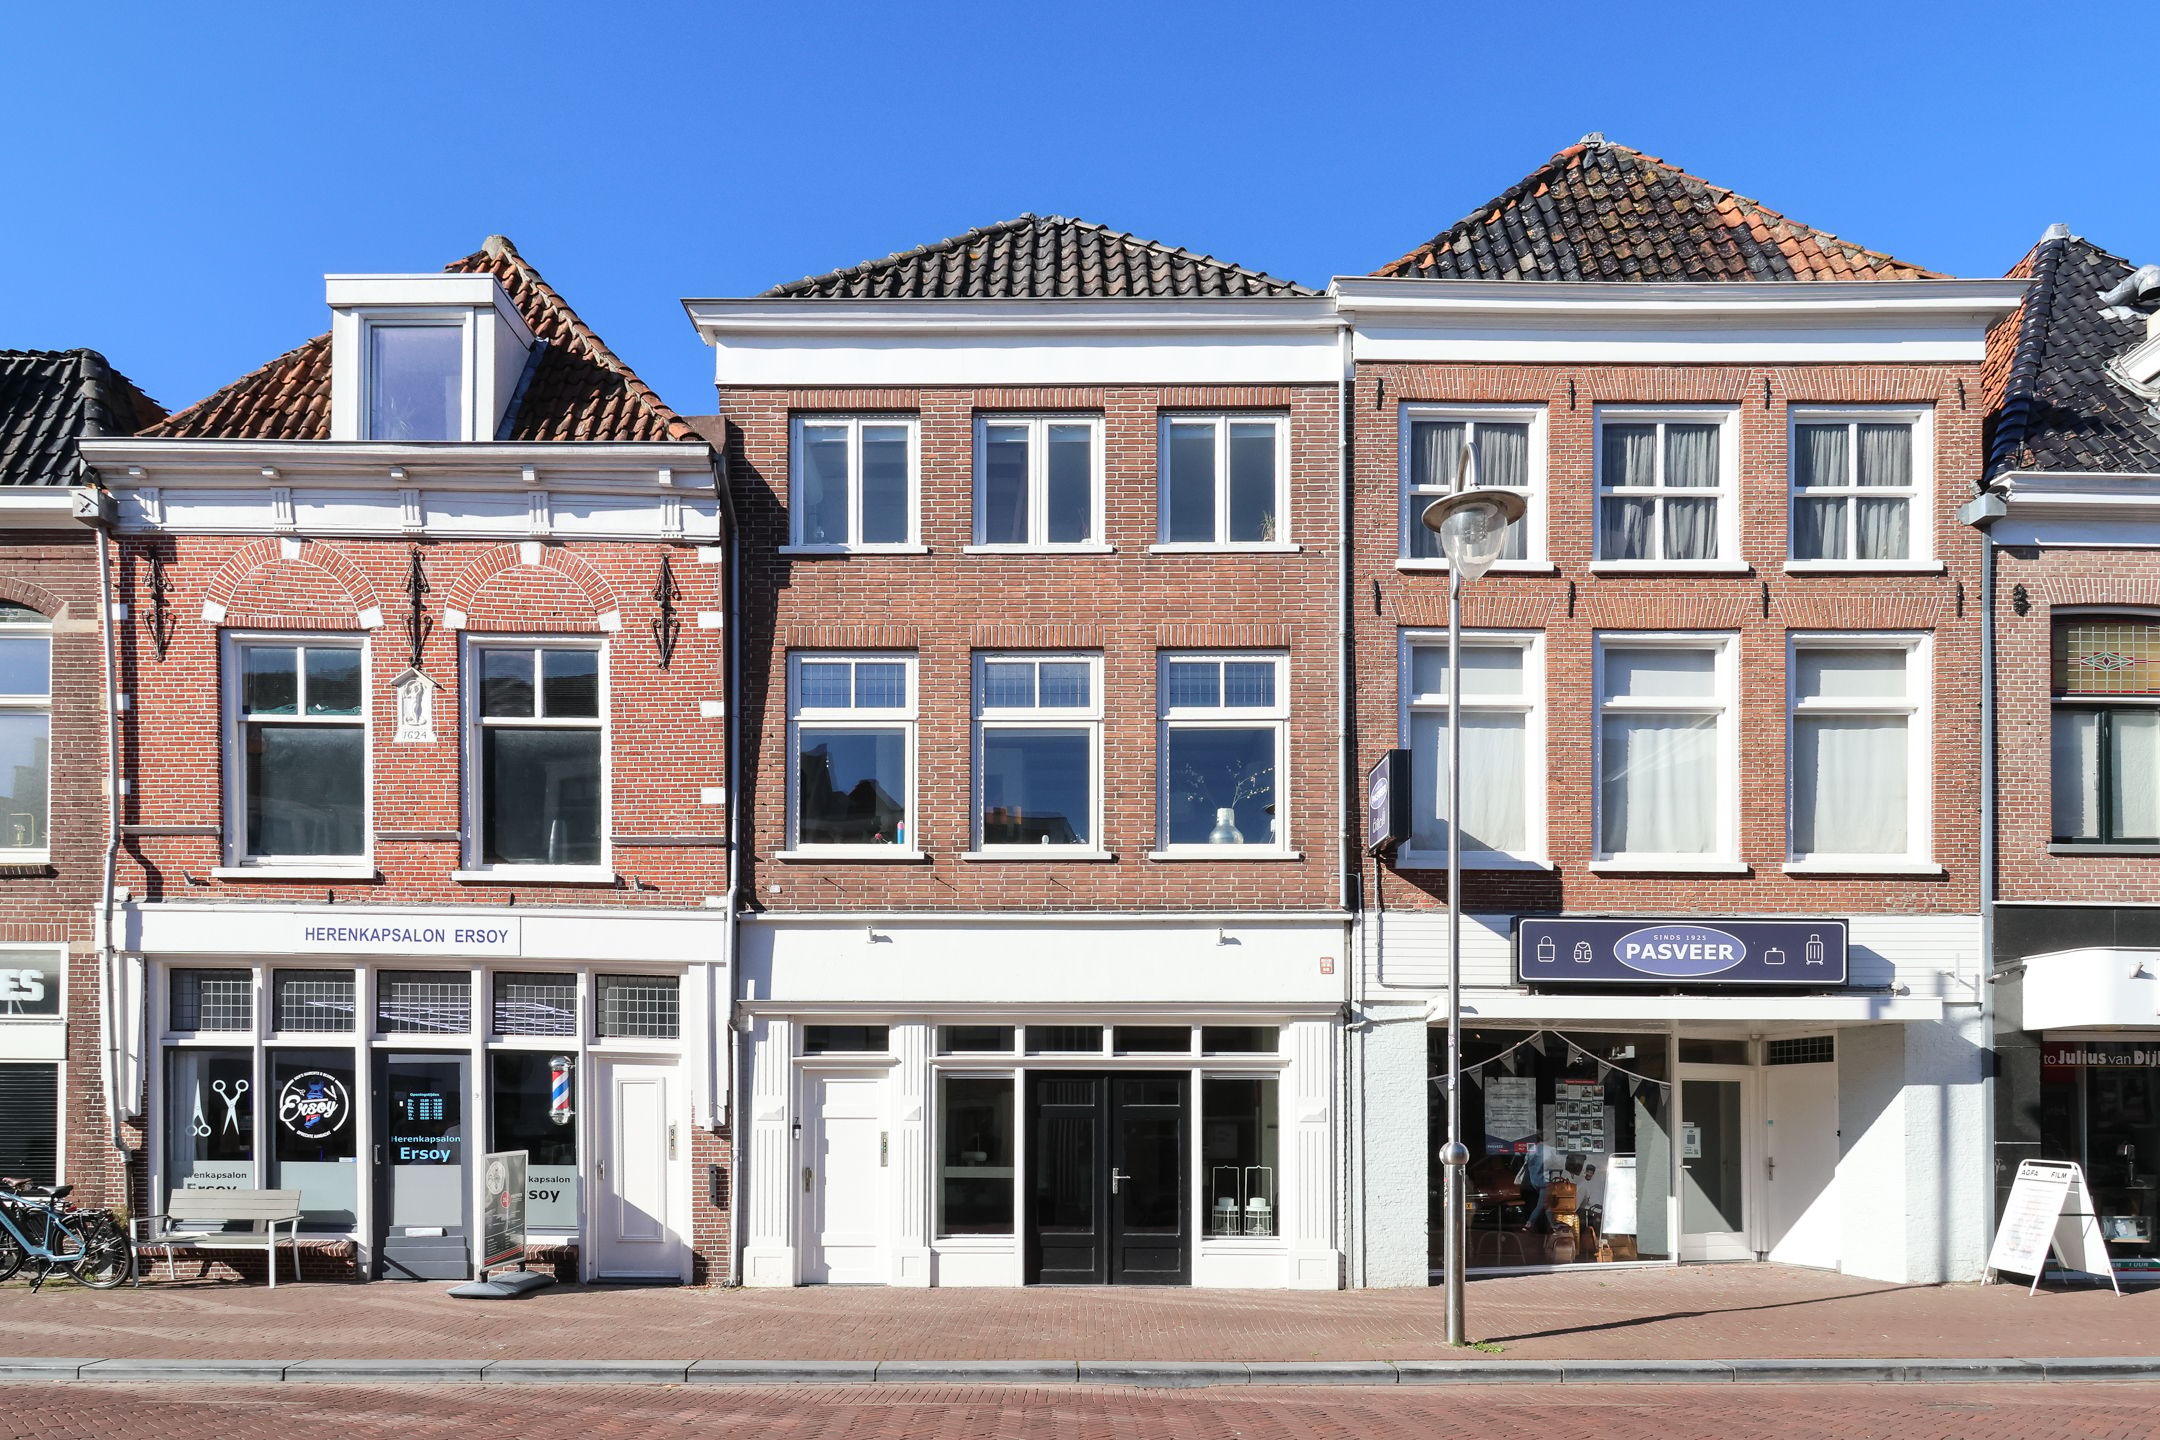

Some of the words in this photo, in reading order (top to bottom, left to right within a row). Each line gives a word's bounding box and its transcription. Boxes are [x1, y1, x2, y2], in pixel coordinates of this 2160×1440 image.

[403, 731, 427, 740] 1624
[305, 927, 445, 943] HERENKAPSALON
[455, 929, 508, 944] ERSOY
[1626, 943, 1735, 960] PASVEER
[0, 969, 45, 1002] ES
[2058, 1050, 2107, 1065] Julius
[2108, 1055, 2132, 1065] van
[2133, 1050, 2160, 1068] Dij
[279, 1094, 339, 1122] Ersoy
[391, 1135, 461, 1144] Herenkapsalon
[400, 1146, 451, 1163] Ersoy
[193, 1171, 247, 1180] enkapsalon
[528, 1175, 571, 1185] kapsalon
[2050, 1170, 2068, 1179] FILM
[528, 1189, 561, 1203] soy
